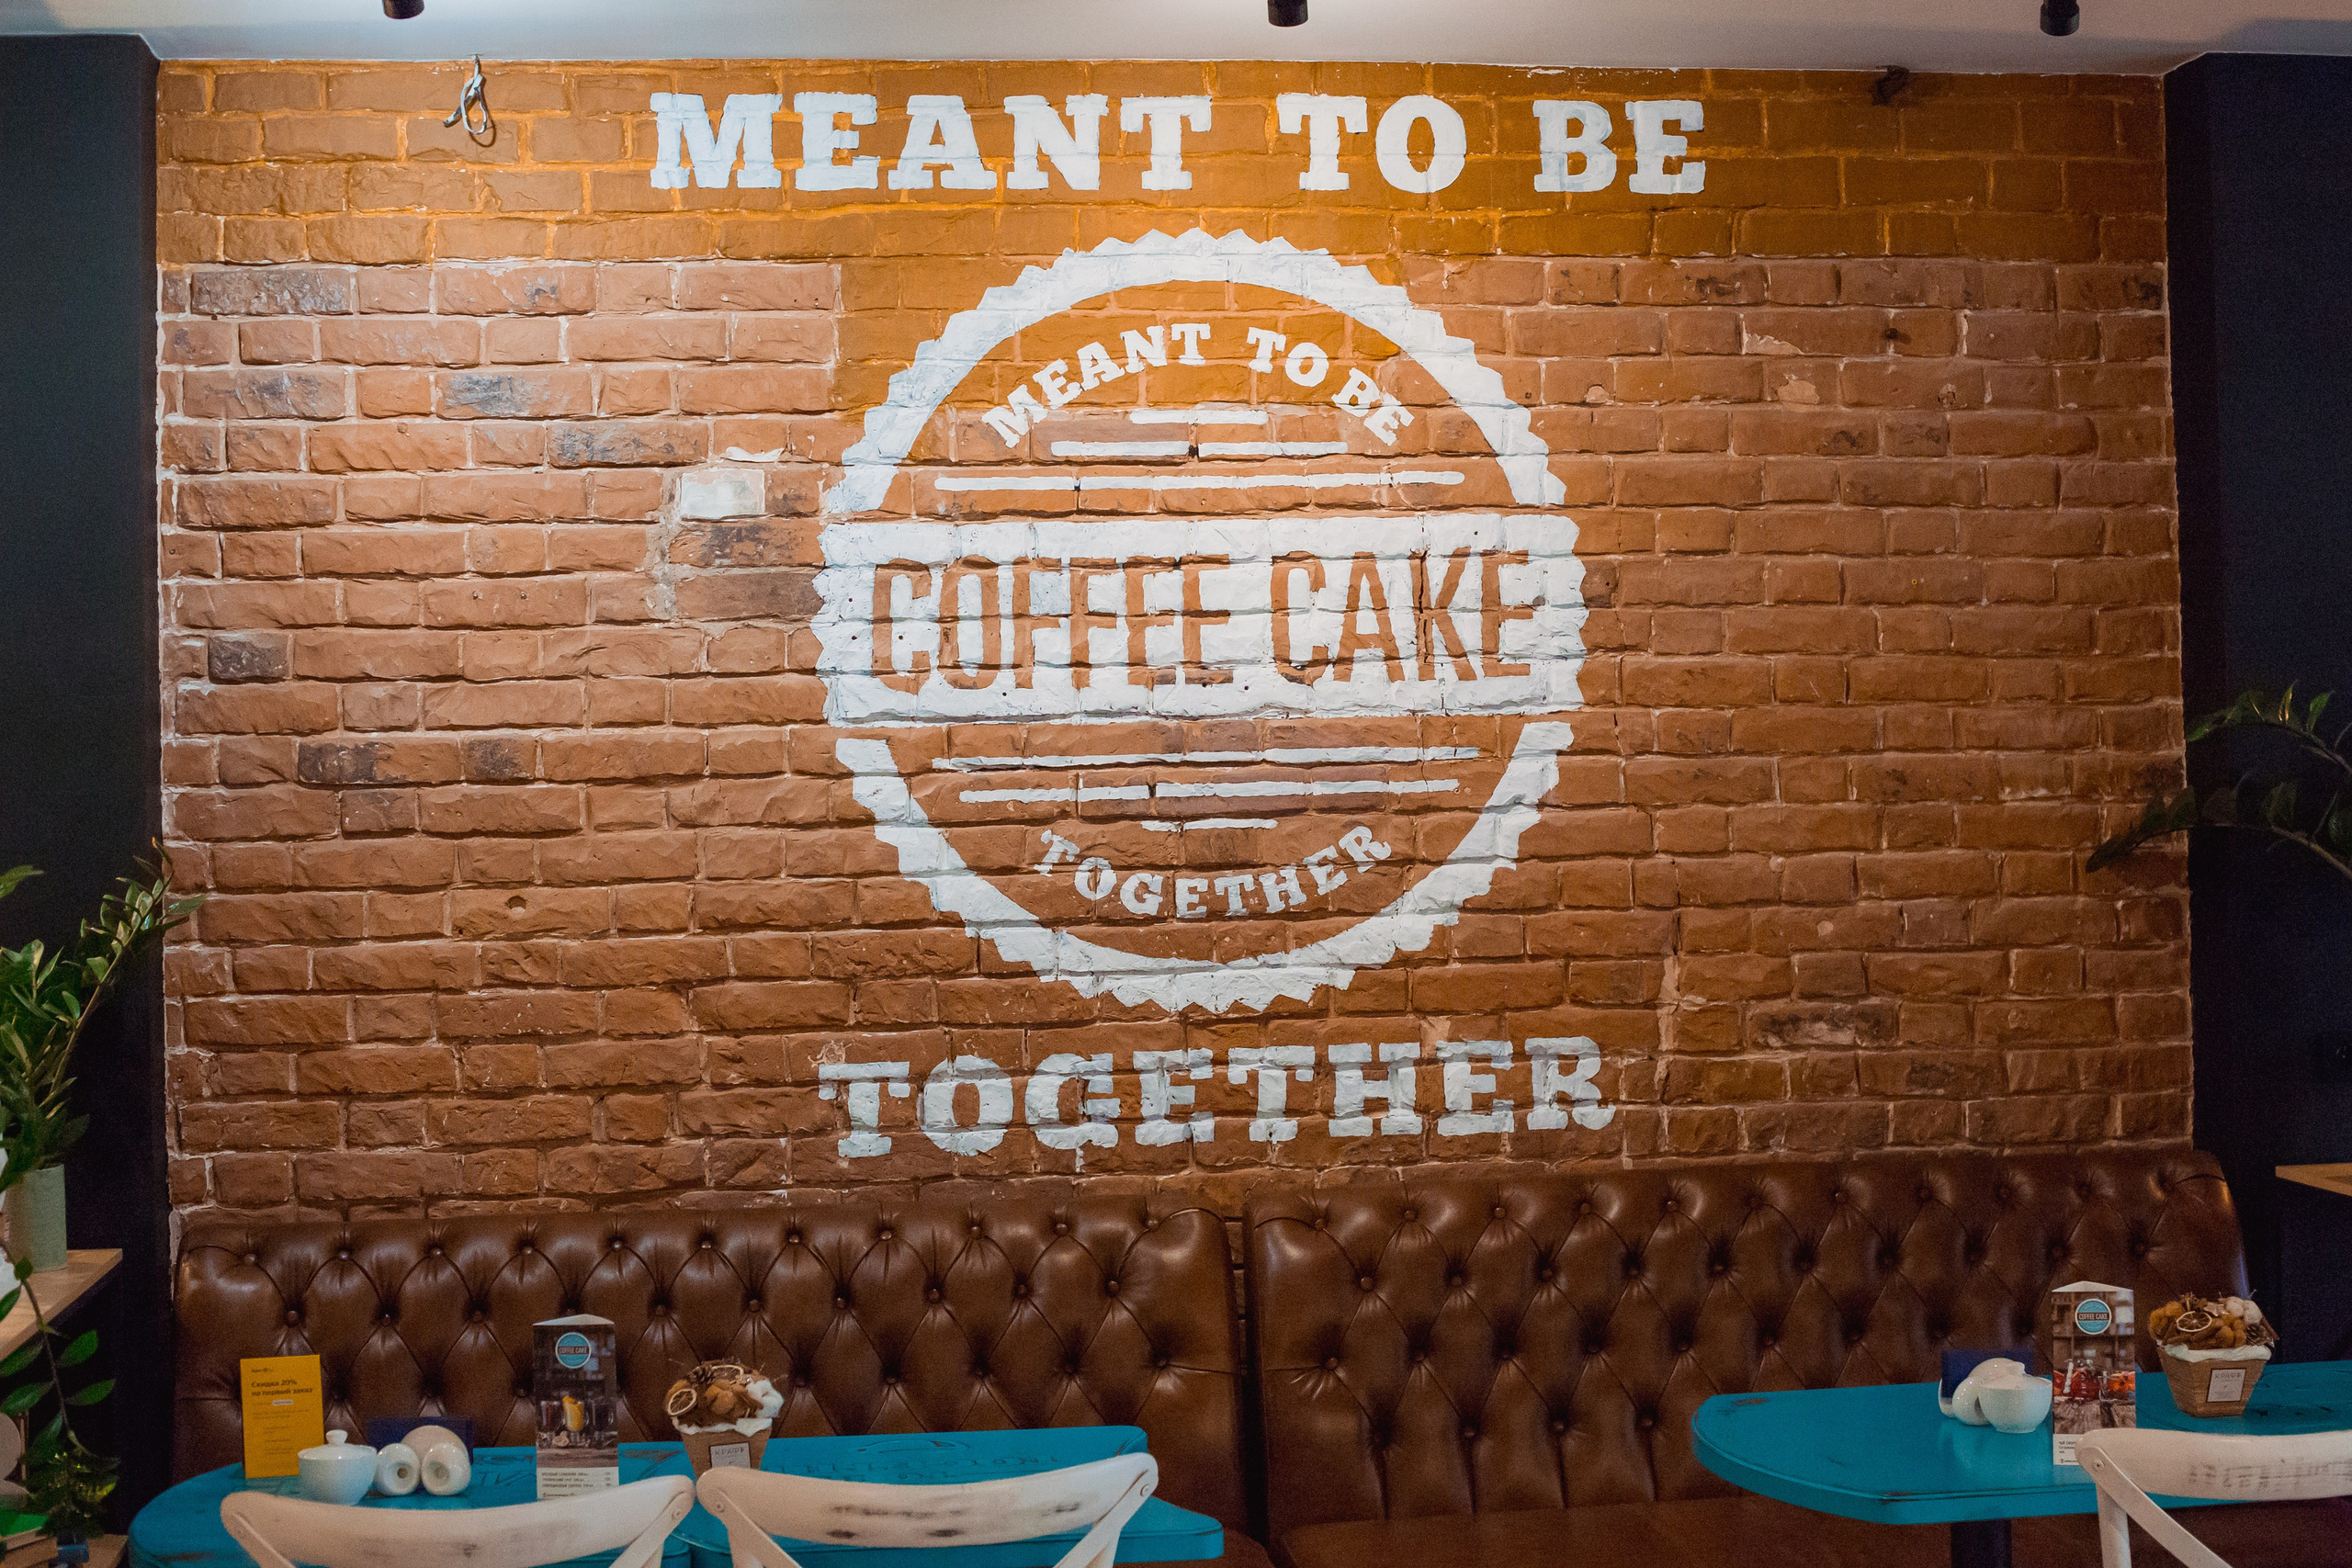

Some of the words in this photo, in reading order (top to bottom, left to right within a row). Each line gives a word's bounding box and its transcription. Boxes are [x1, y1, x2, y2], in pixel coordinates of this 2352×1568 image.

[649, 92, 1212, 191] MEANT
[1275, 94, 1467, 194] TO
[1532, 99, 1705, 195] BE
[980, 322, 1211, 448] MEANT
[1246, 326, 1329, 387] TO
[1330, 367, 1415, 446] BE
[871, 553, 1234, 693] COFFEE
[1271, 547, 1535, 685] CAKE
[1034, 825, 1392, 918] TOGETHER
[818, 1036, 1615, 1157] TOGETHER
